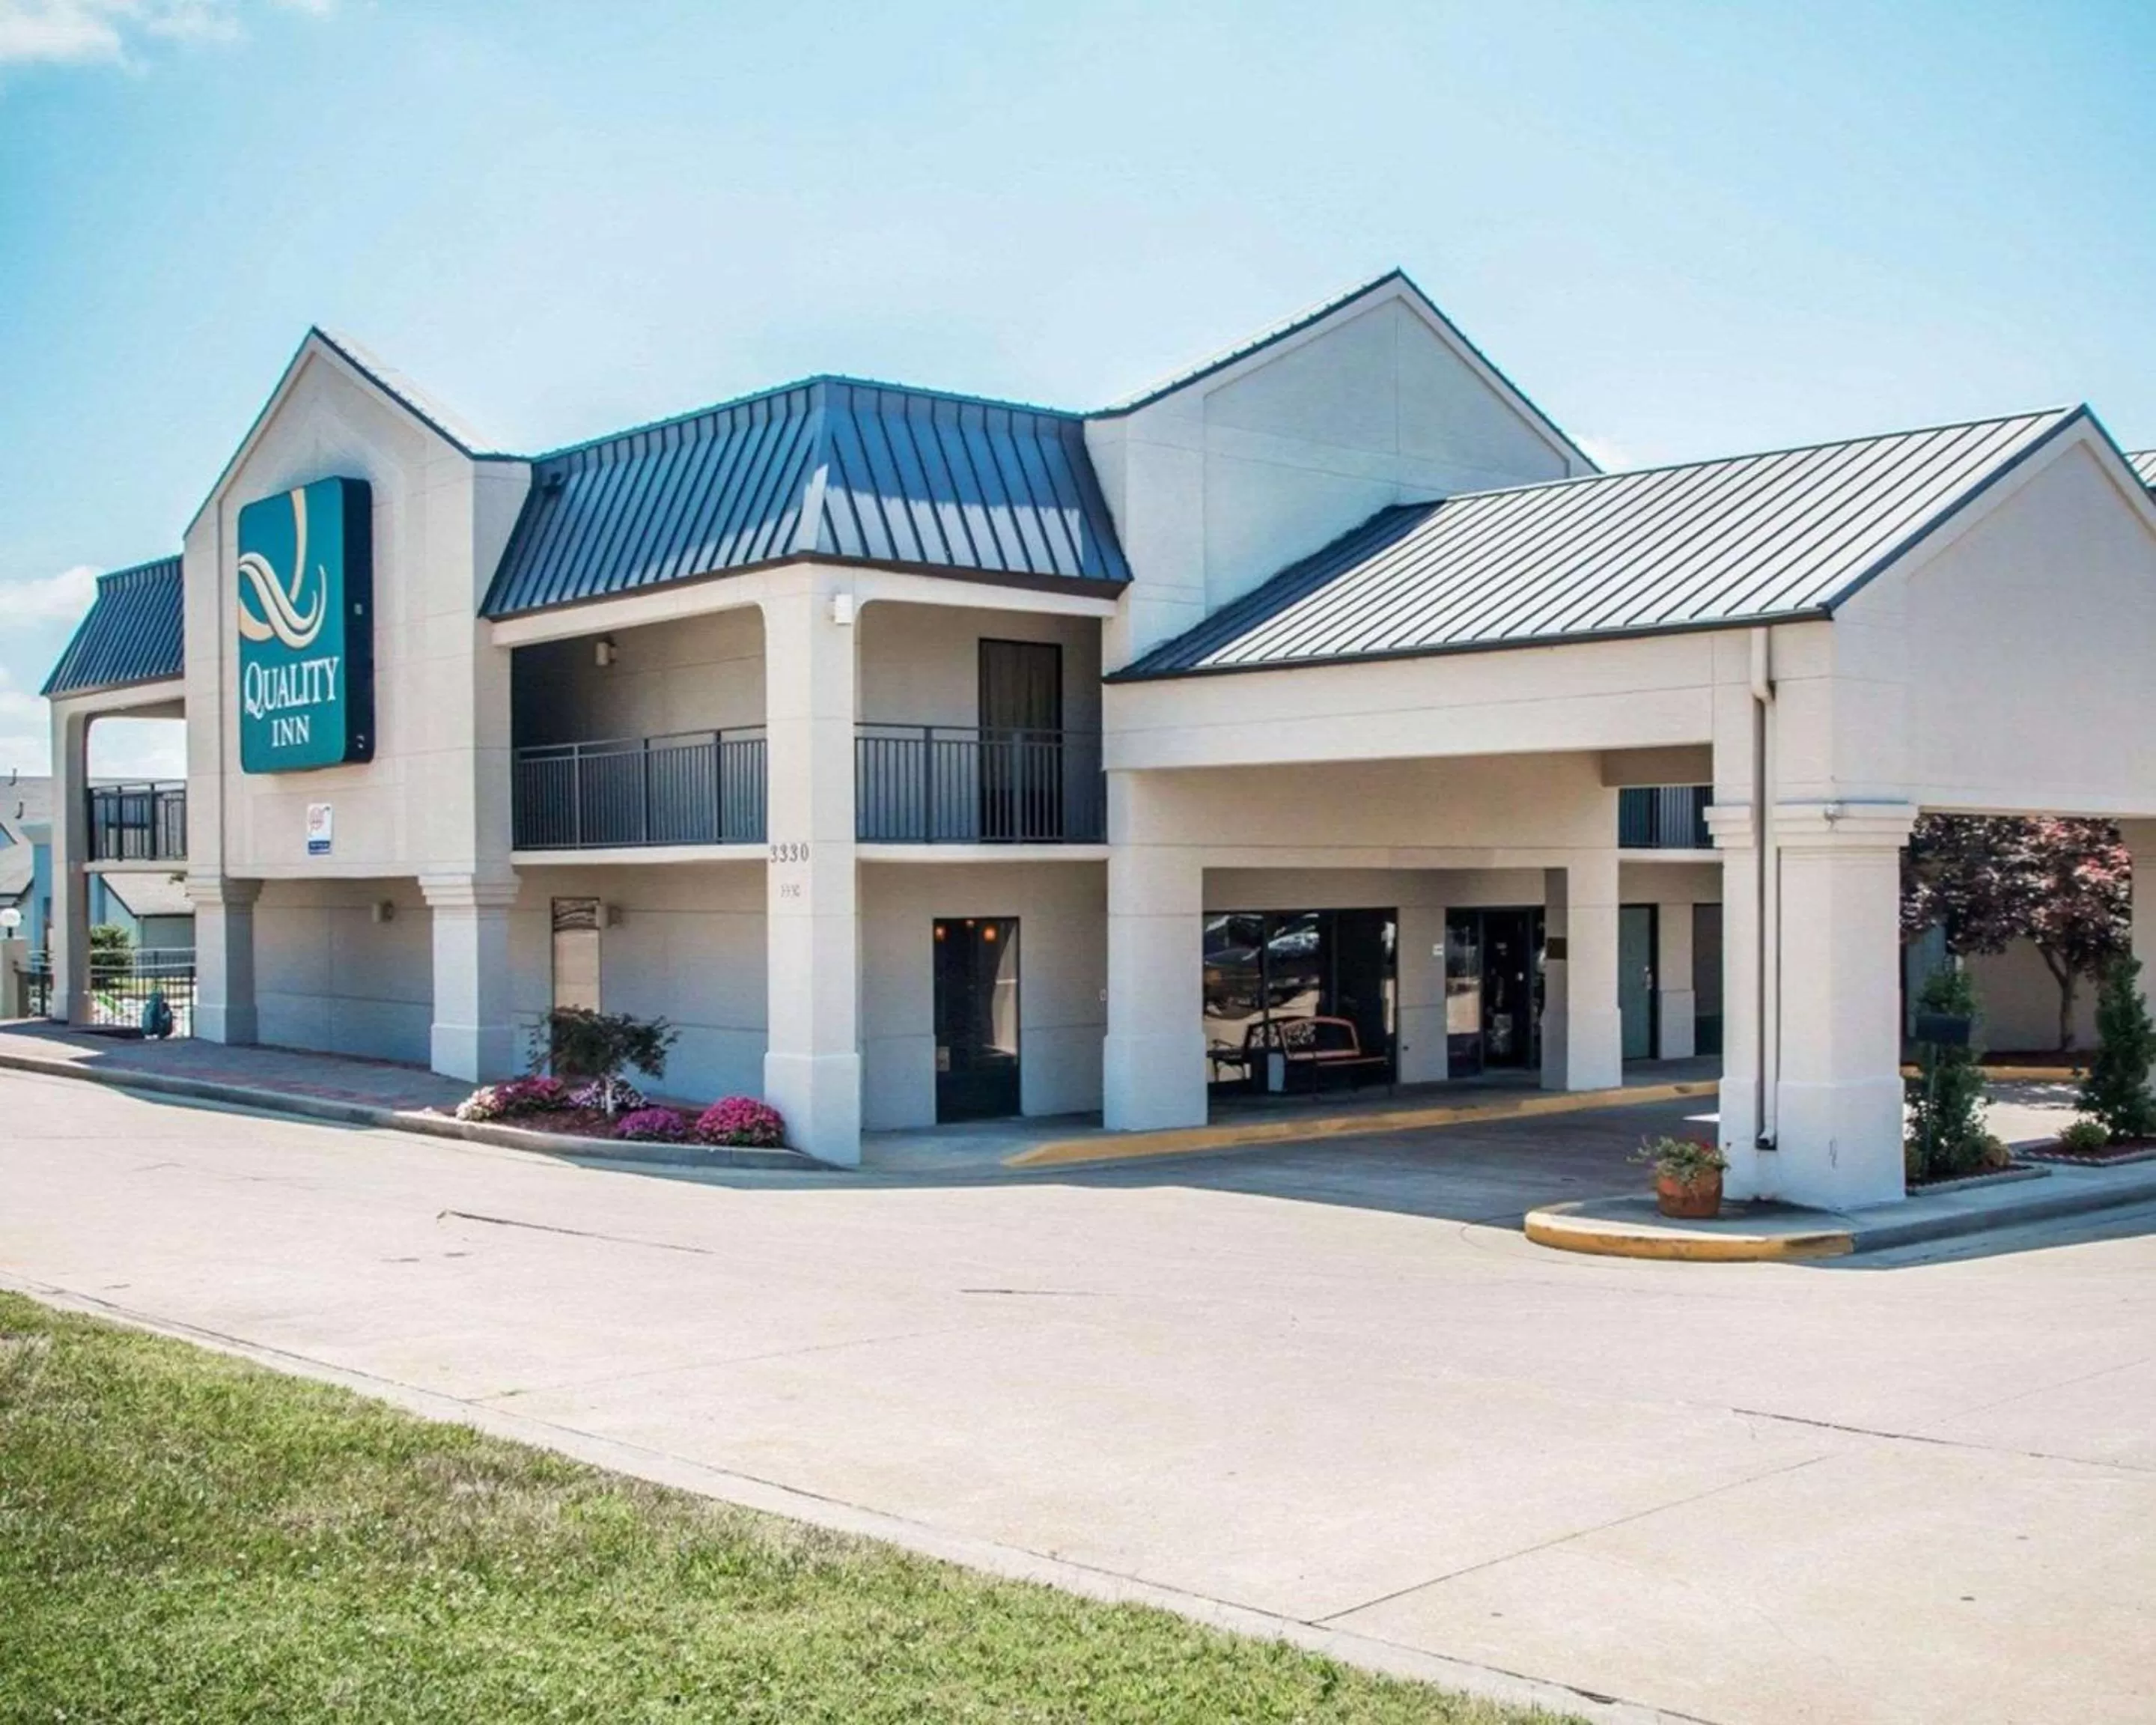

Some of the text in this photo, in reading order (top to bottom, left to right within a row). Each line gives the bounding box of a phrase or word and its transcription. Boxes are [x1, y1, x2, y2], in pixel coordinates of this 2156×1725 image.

[245, 657, 340, 719] QUALITY
[271, 715, 310, 747] INN
[770, 842, 810, 862] 3330
